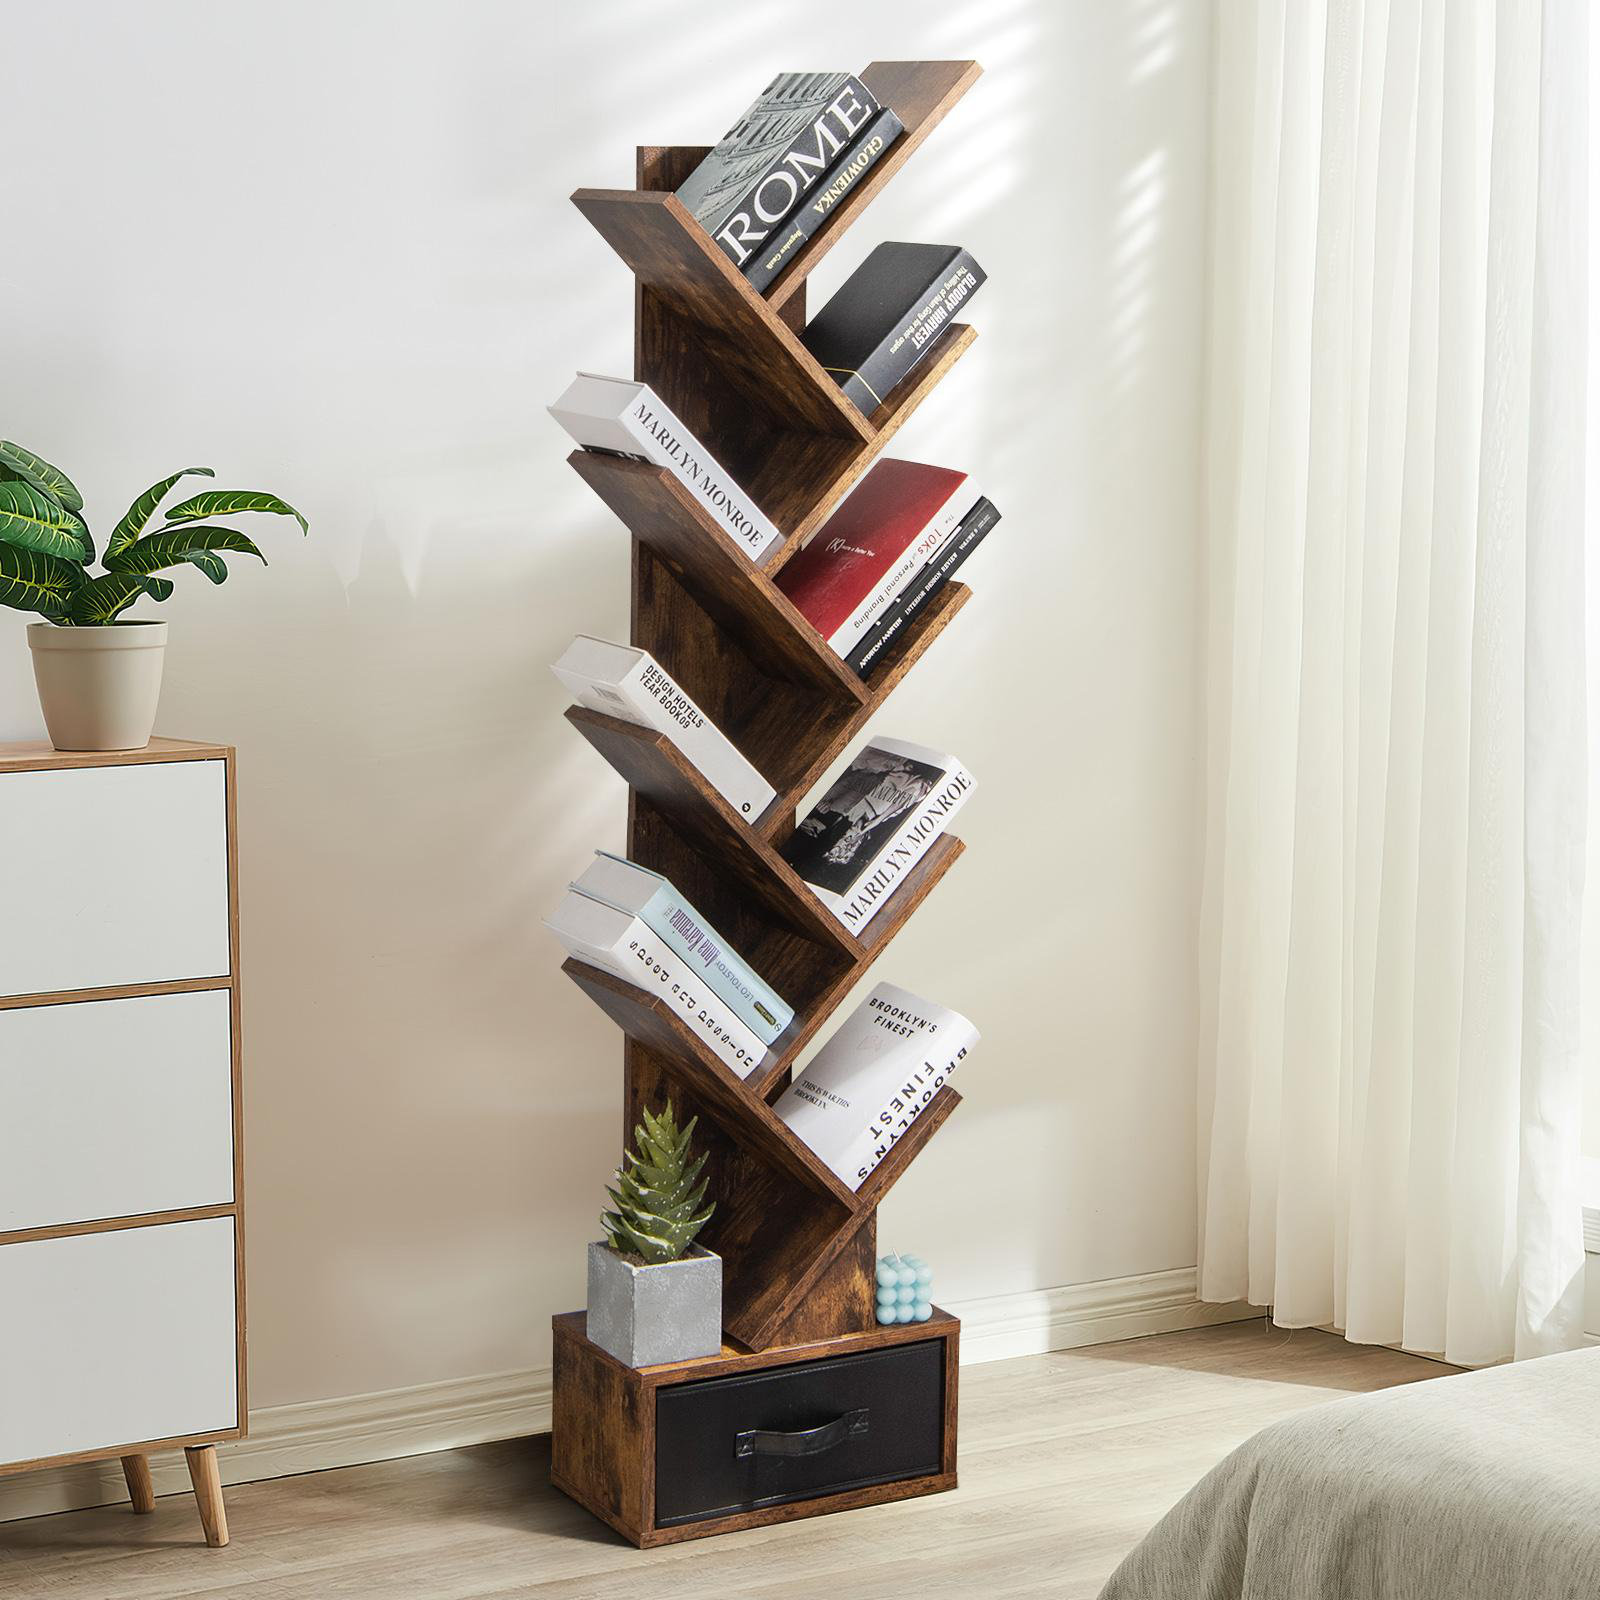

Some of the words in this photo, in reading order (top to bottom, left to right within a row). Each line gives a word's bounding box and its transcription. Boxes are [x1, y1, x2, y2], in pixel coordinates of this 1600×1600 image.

[716, 86, 872, 266] ROME
[944, 272, 977, 311] BLOODY
[911, 306, 948, 350] HARVEST
[634, 404, 703, 480] MARILYN
[699, 475, 764, 547] MONROE
[917, 529, 942, 555] 10Ks
[885, 561, 915, 596] Personal
[854, 595, 885, 629] Branding
[640, 673, 661, 697] YEAR
[646, 665, 675, 697] DESIGN
[673, 695, 704, 728] HOTELS
[843, 843, 912, 925] MARILYN
[907, 771, 971, 849] MONROE
[669, 908, 705, 952] Karenina
[697, 938, 721, 968] Anna
[715, 960, 741, 991] TOLSTOY
[740, 988, 754, 1001] LEO
[629, 941, 670, 982] speed
[671, 983, 697, 1009] and
[698, 1010, 753, 1067] passion
[869, 998, 938, 1033] BROOKLYN'S
[874, 1016, 915, 1038] FINEST
[858, 1047, 968, 1180] BROOKLYN'S
[869, 1061, 935, 1140] FINEST
